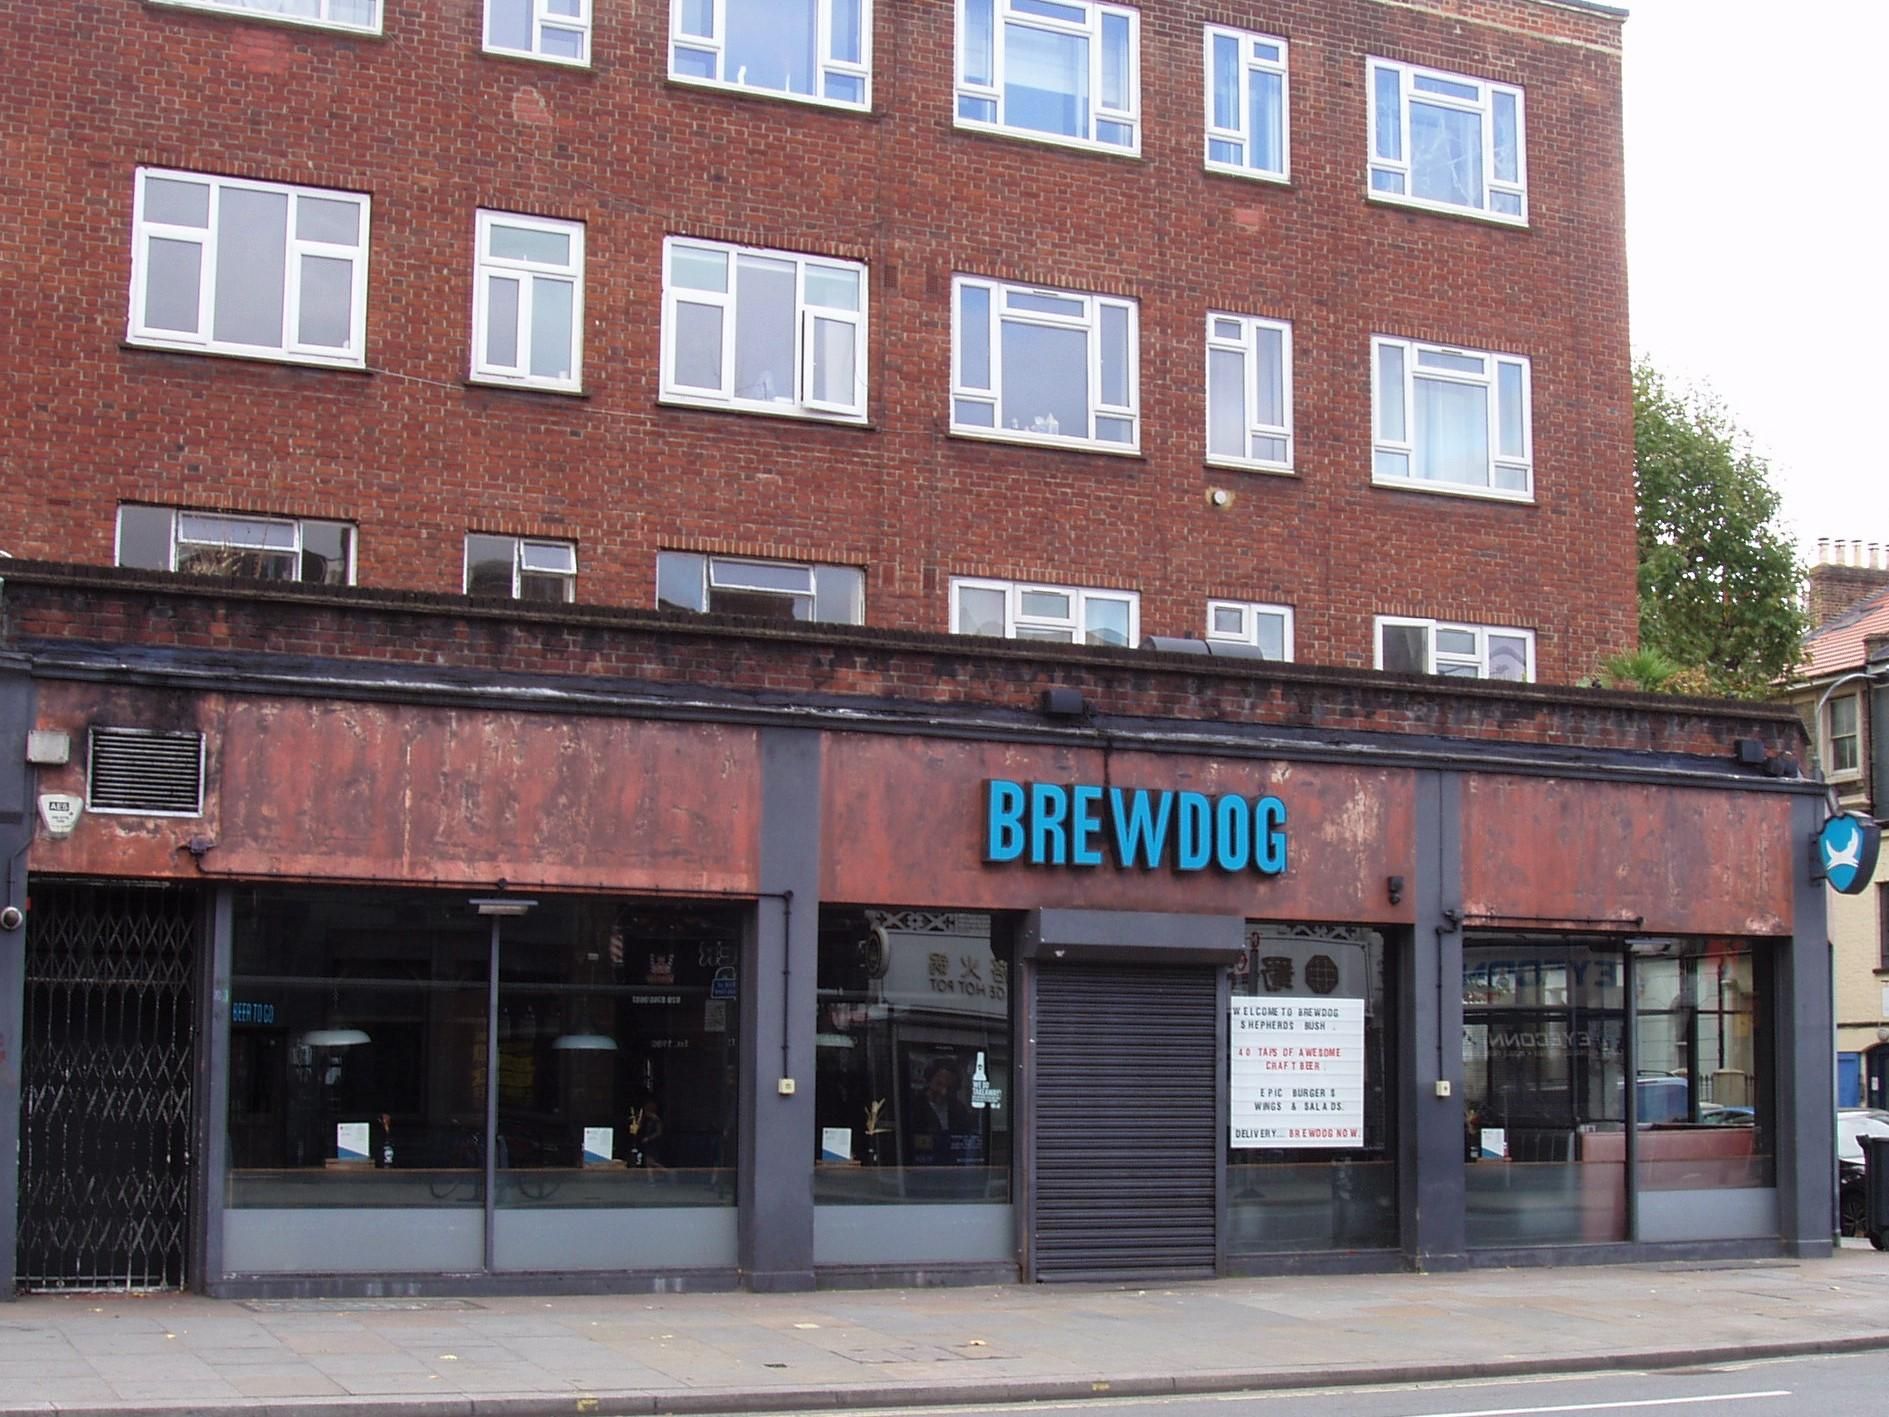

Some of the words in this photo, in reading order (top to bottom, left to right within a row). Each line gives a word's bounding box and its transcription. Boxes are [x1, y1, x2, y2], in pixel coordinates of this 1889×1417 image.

[986, 779, 1287, 873] BREWDOG
[1233, 1007, 1278, 1017] WELCOME
[1281, 1007, 1293, 1017] TO
[1298, 1007, 1339, 1017] BREWDOG
[1240, 1020, 1294, 1030] SHEPHERDS
[1238, 1048, 1251, 1057] 40
[1258, 1047, 1278, 1057] TAPS
[1282, 1047, 1294, 1057] OF
[1299, 1048, 1341, 1058] AWESOME
[1265, 1061, 1296, 1070] CRAFT
[1260, 1088, 1283, 1098] EPIC
[1292, 1088, 1336, 1098] BURGERS
[1254, 1102, 1282, 1111] WINGS
[1291, 1102, 1297, 1111] &
[1289, 1128, 1334, 1139] BREWDOG
